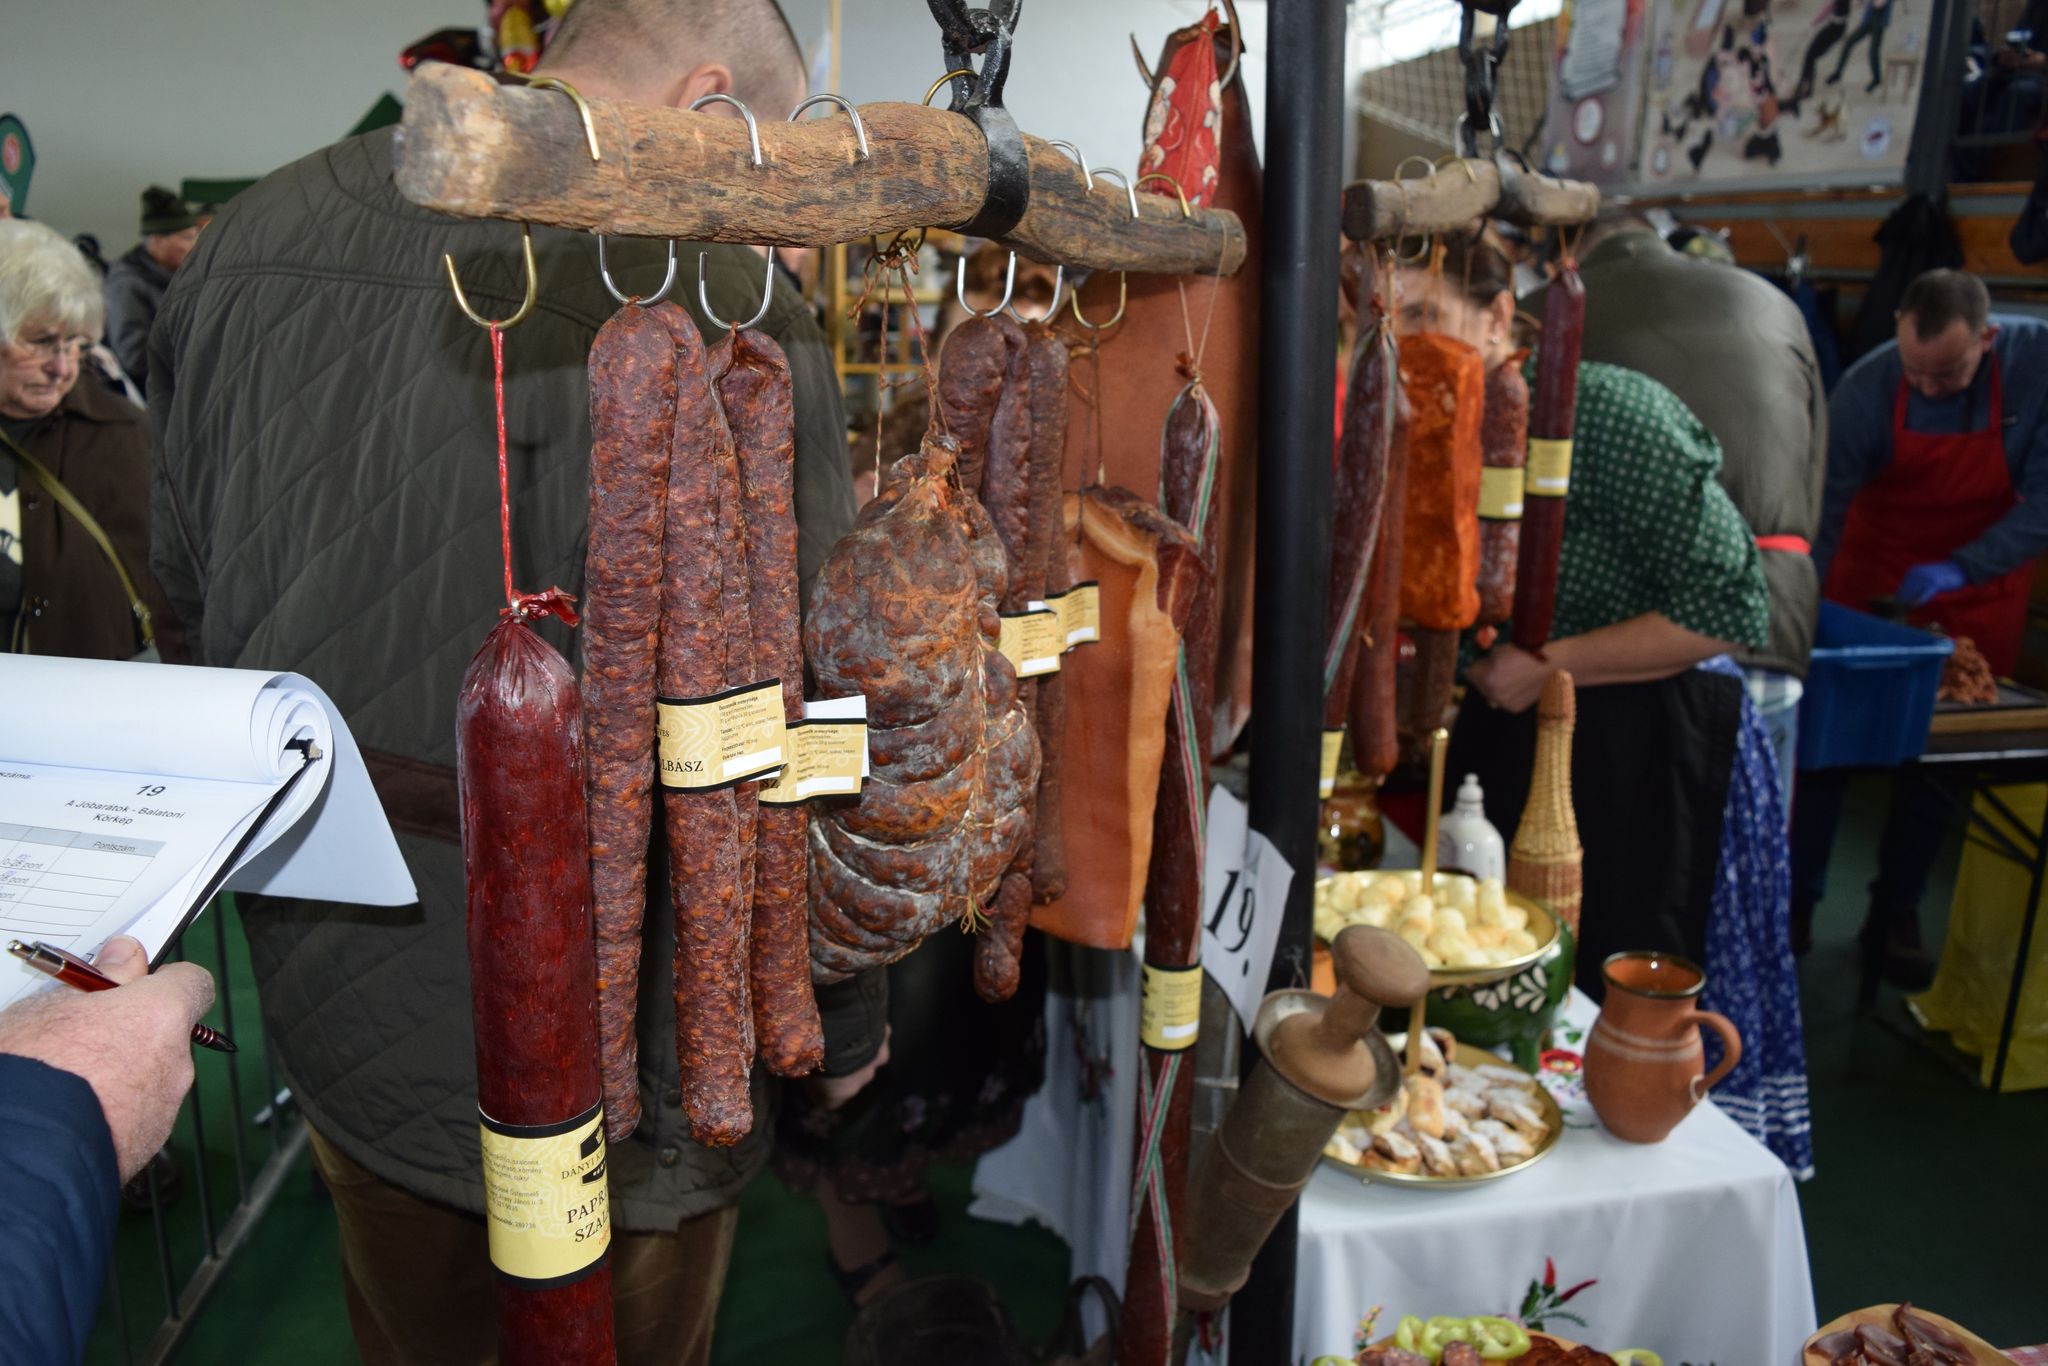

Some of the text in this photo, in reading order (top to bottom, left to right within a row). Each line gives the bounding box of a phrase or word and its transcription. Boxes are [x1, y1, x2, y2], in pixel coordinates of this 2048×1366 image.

[136, 784, 166, 797] 19
[65, 799, 74, 807] A
[75, 800, 130, 814] Jóbarátok
[138, 807, 186, 819] Balatoni
[93, 813, 134, 826] Körkép
